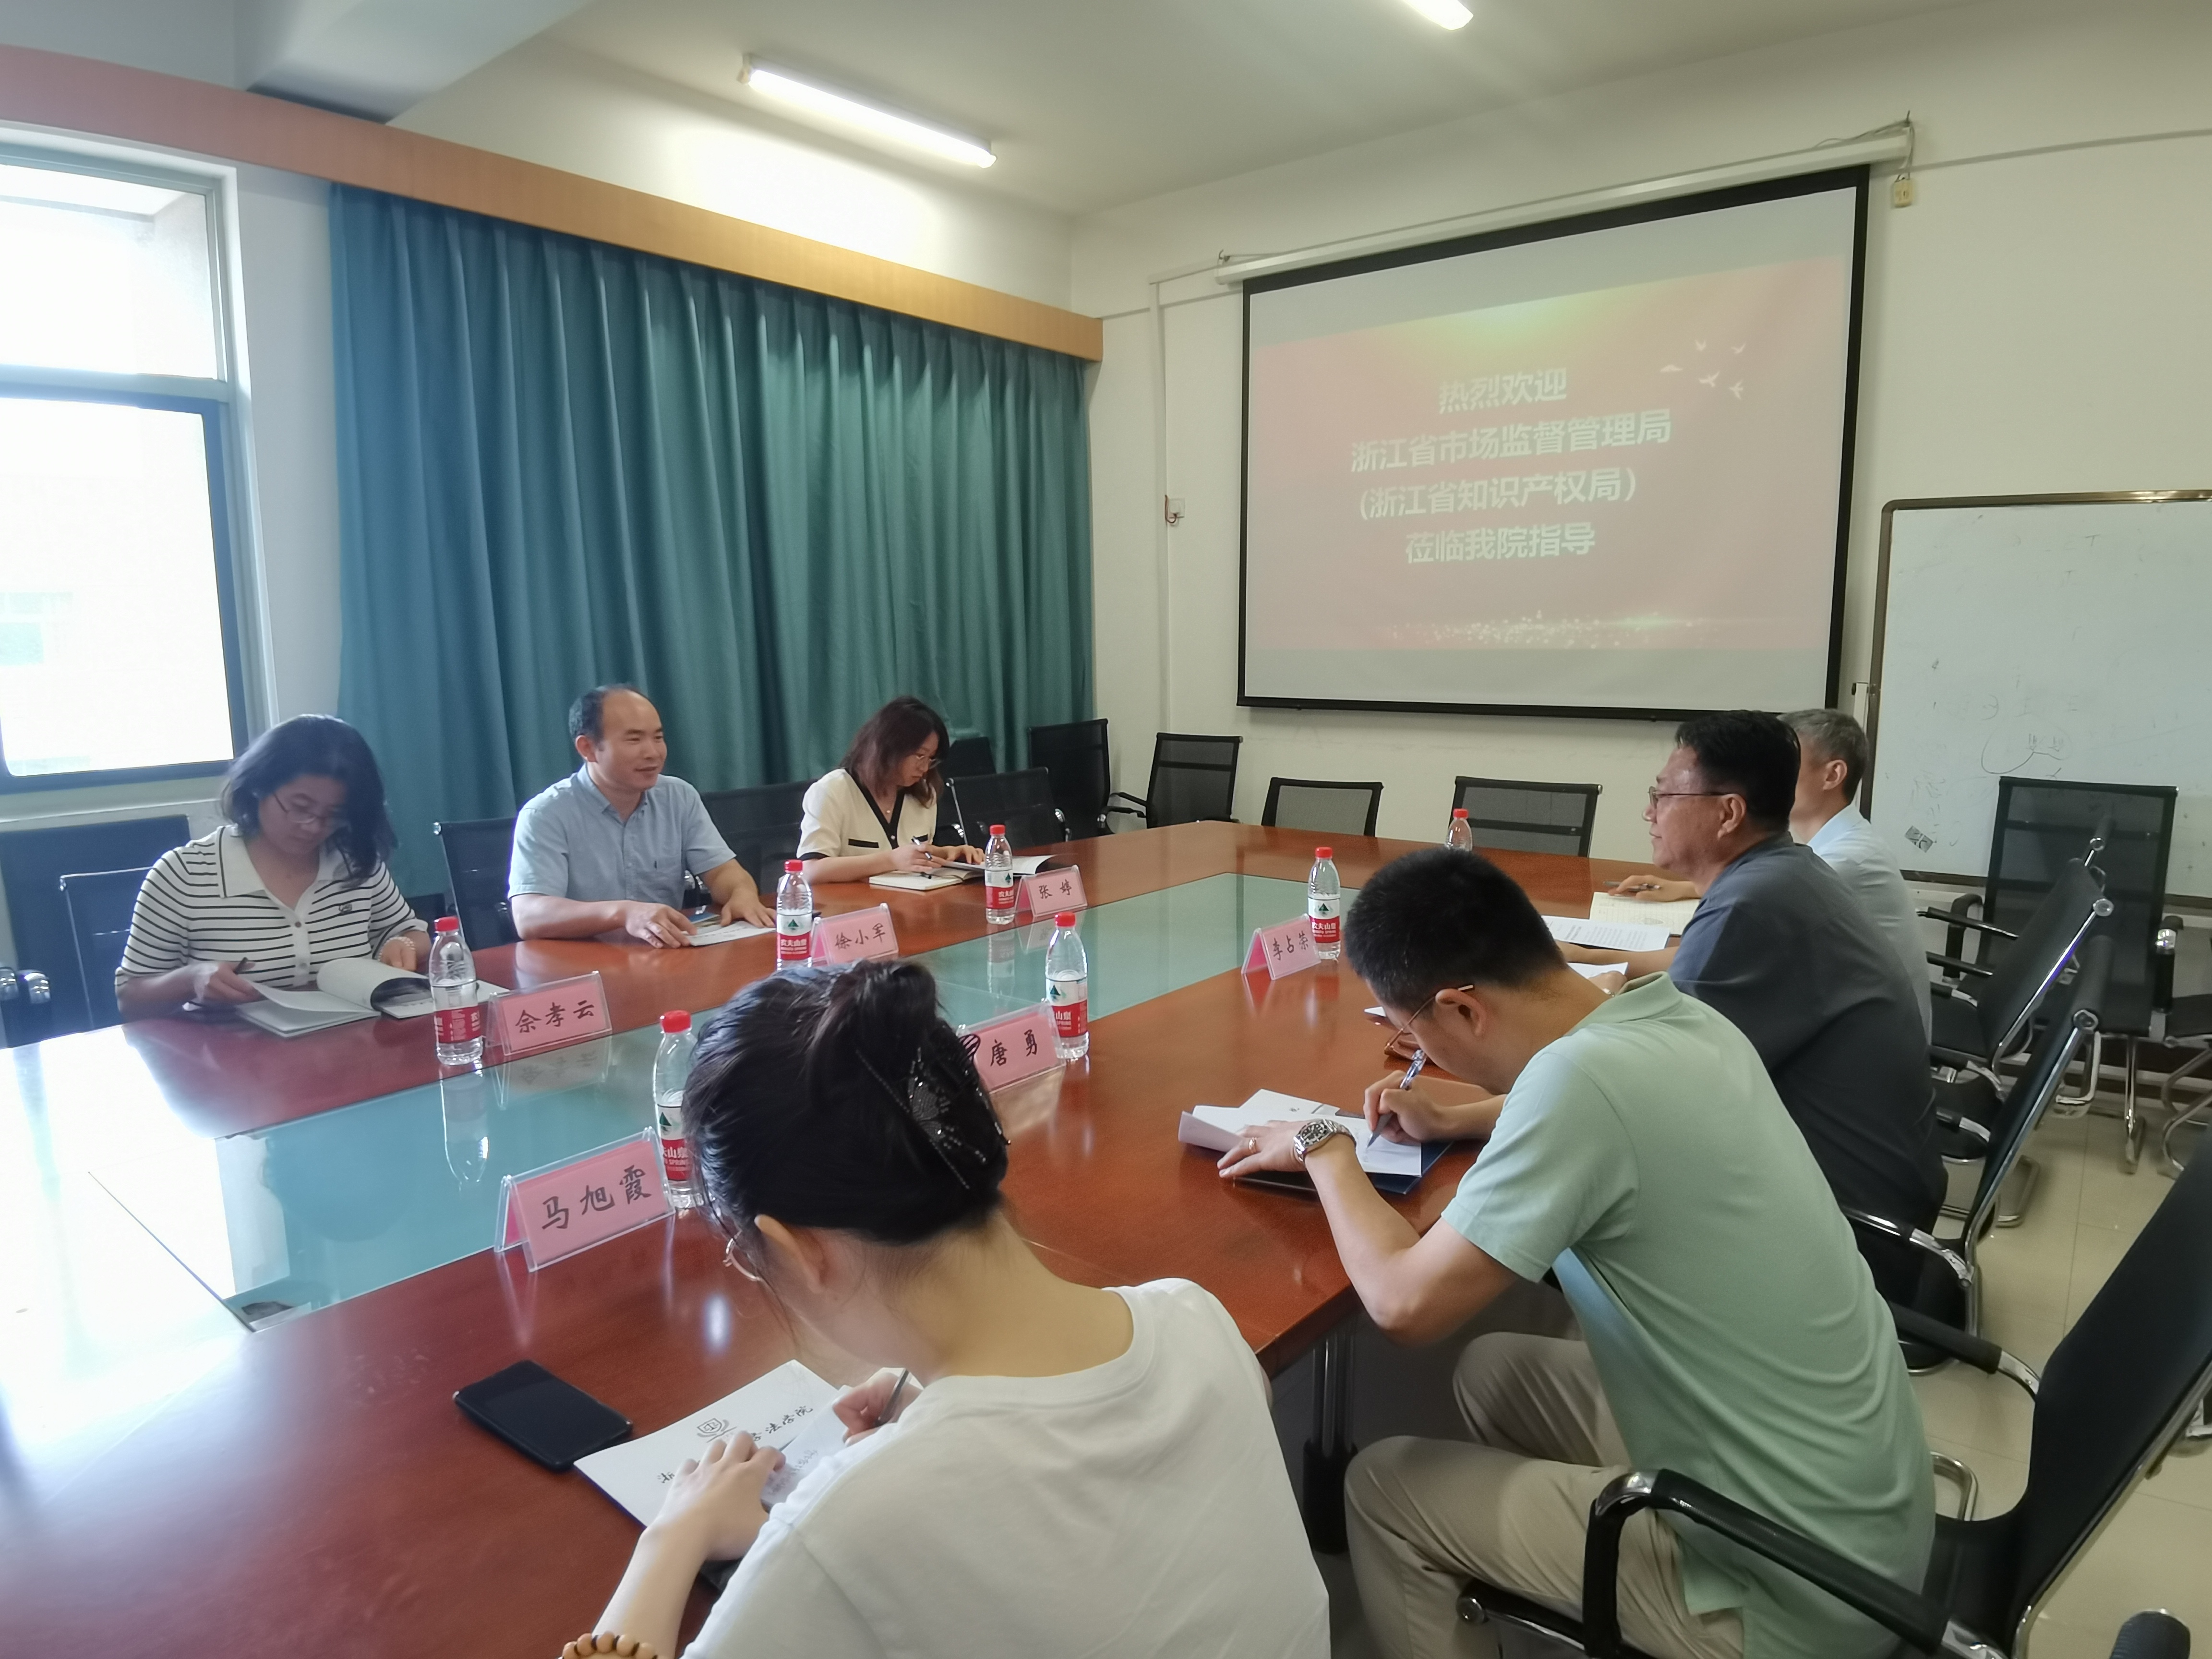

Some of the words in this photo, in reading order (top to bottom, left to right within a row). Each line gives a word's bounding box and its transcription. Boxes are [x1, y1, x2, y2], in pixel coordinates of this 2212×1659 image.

[1439, 367, 1567, 414] 热烈欢迎
[1351, 408, 1671, 472] 浙江省市场监督管理局
[1360, 468, 1636, 520] (浙江省知识产权局)
[1405, 522, 1596, 564] 莅临我院指导
[1038, 878, 1072, 899] 张婷
[835, 923, 886, 950] 徐小军
[1273, 930, 1309, 961] 李占荣
[990, 1029, 1038, 1067] 唐勇
[541, 1164, 652, 1230] 马旭霞
